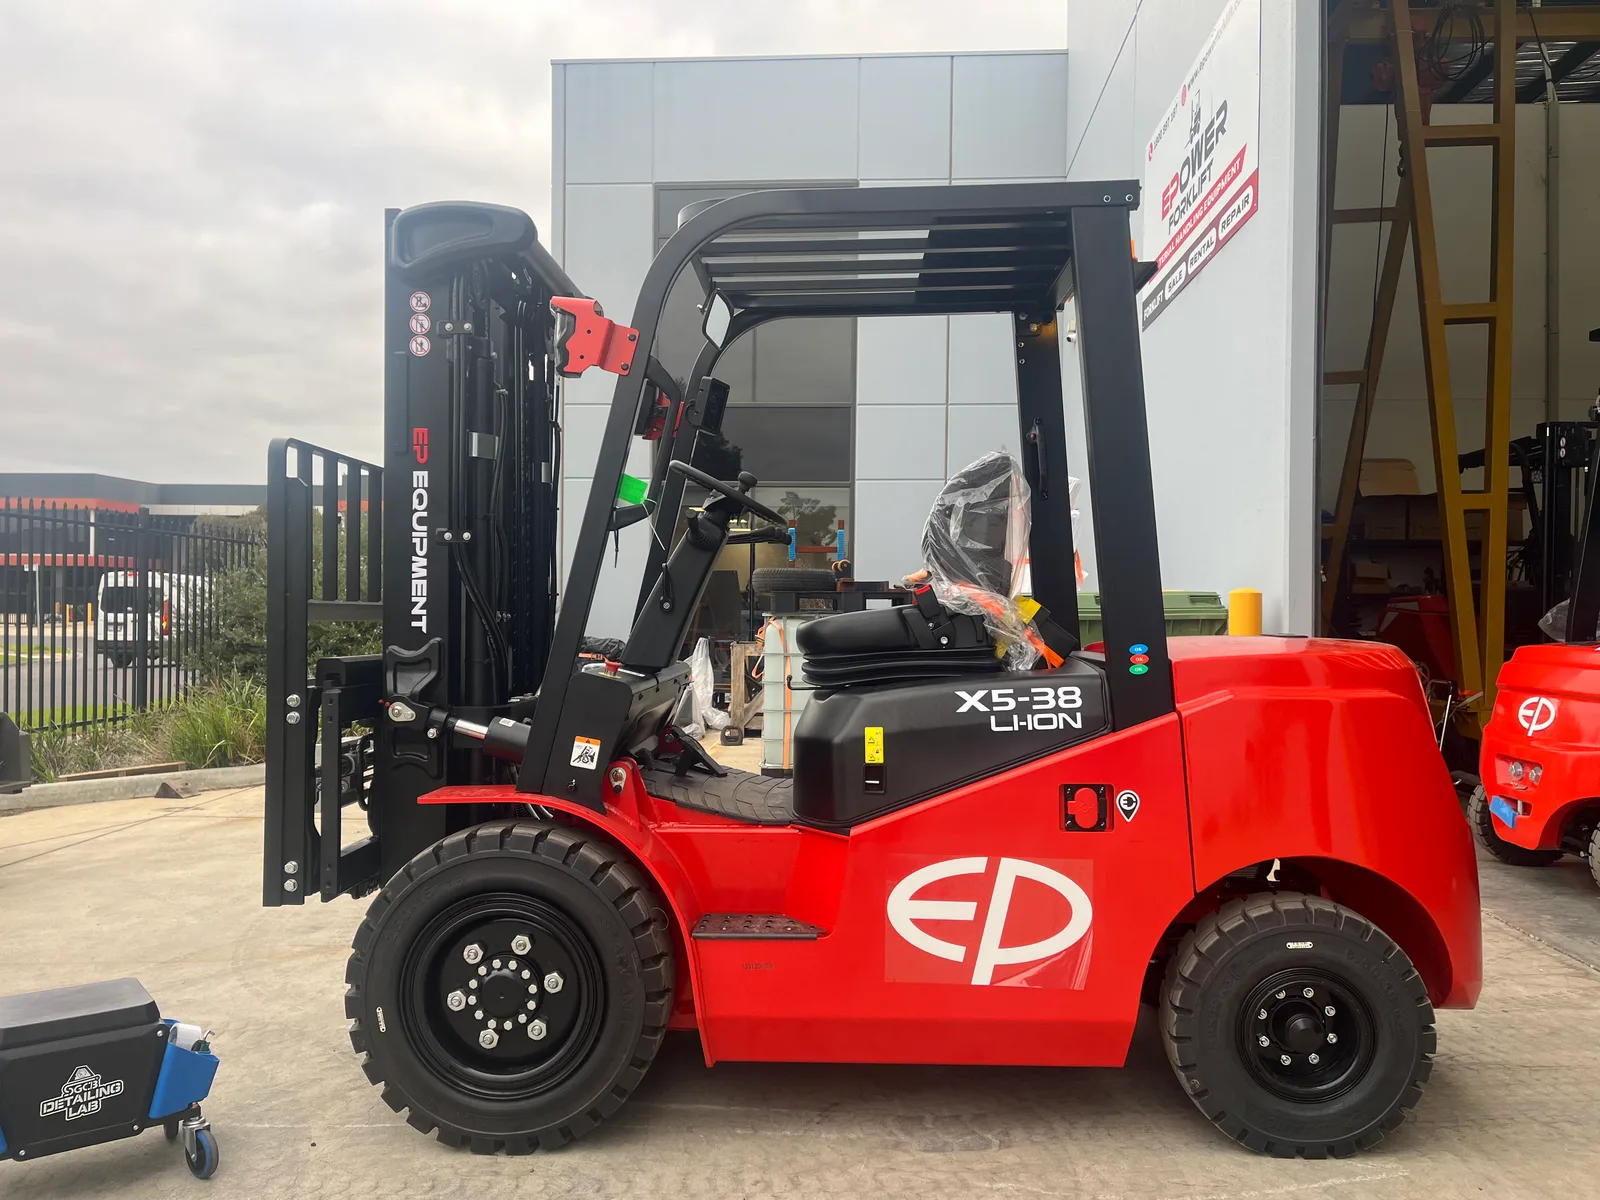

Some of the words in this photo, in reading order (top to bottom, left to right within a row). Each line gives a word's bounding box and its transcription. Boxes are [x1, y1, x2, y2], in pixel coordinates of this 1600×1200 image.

[1162, 99, 1228, 220] EPOWER
[1168, 157, 1214, 235] FORKLIFT
[1175, 204, 1205, 247] HANDLING
[1203, 158, 1241, 213] EQUIPMENT
[1144, 290, 1164, 318] FORKLIFT
[1168, 270, 1183, 292] SALE
[1189, 238, 1215, 269] RENTAL
[1221, 193, 1250, 233] REPAIR
[413, 427, 429, 464] EP
[411, 470, 429, 635] EQUIPMENT
[954, 686, 1083, 713] X5-38
[1517, 696, 1556, 737] EP
[989, 711, 1083, 732] LI-ION
[886, 856, 1093, 986] EP
[43, 1082, 121, 1114] DETAILING
[63, 1078, 99, 1097] SGCB
[68, 1100, 99, 1118] LAB
